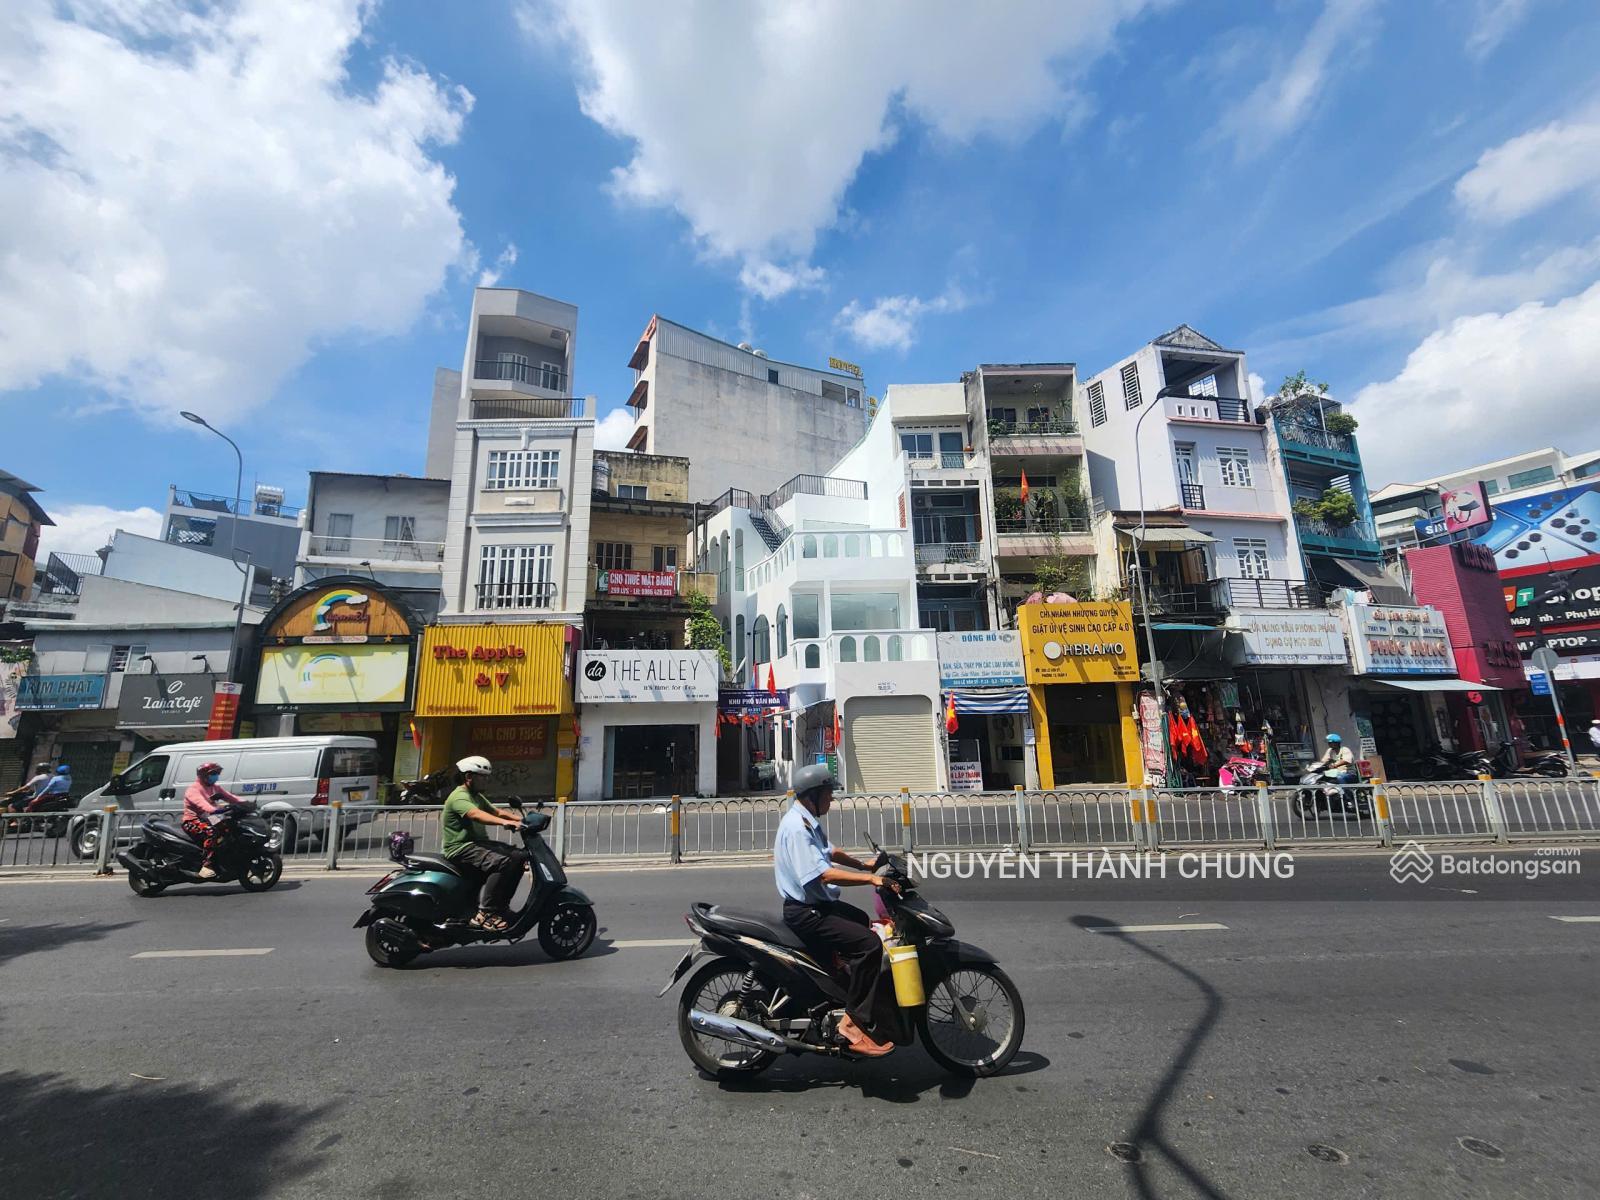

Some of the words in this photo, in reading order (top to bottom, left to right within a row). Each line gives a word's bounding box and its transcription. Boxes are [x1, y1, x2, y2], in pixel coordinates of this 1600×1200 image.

[610, 573, 623, 584] CHO
[1564, 610, 1587, 619] Phụ
[1058, 622, 1067, 634] VỆ
[1069, 624, 1086, 633] SINH
[1087, 624, 1101, 632] CAO
[1103, 621, 1117, 632] CẤP
[432, 645, 468, 660] The
[472, 645, 525, 662] Apple
[1063, 642, 1124, 656] HERAMO
[611, 660, 640, 680] THE
[647, 660, 700, 681] ALLEY
[475, 673, 491, 687] &
[495, 673, 509, 688] V
[175, 696, 203, 713] Café
